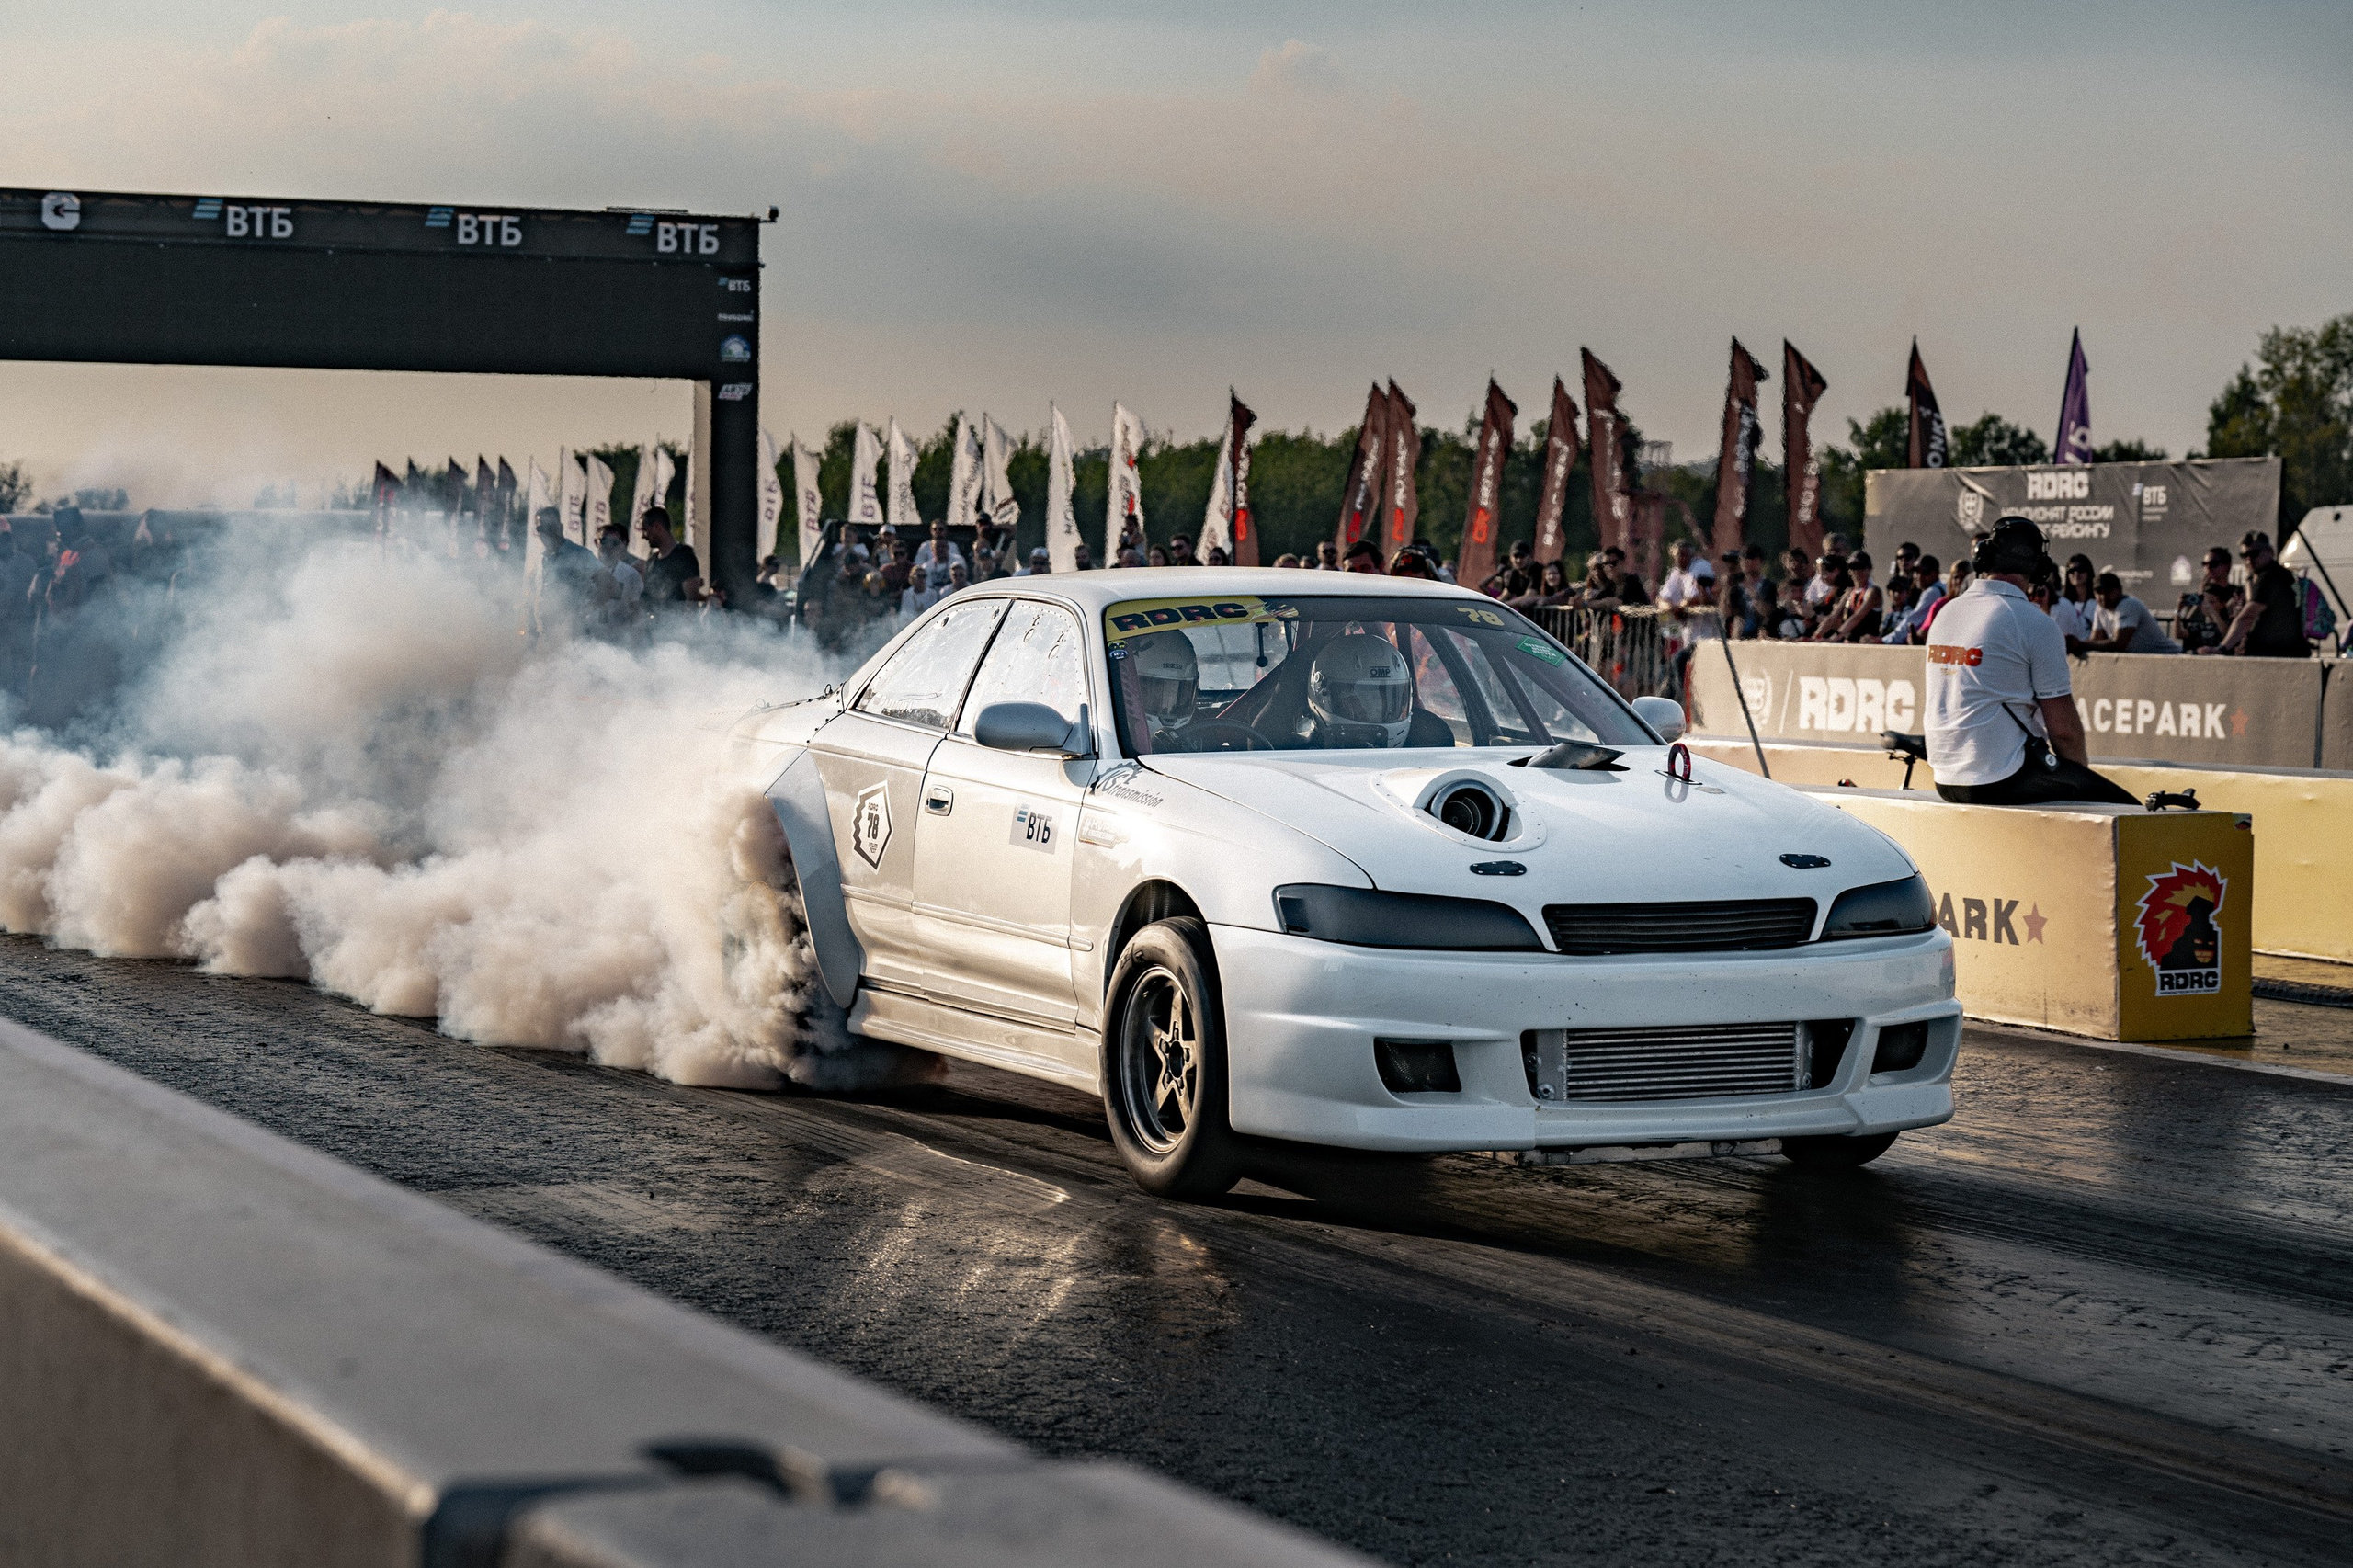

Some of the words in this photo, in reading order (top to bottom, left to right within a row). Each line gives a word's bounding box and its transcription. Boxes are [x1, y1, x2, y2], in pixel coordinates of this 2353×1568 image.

[226, 205, 293, 239] ВТБ
[456, 214, 523, 247] ВТБ
[657, 222, 720, 255] ВТБ
[727, 279, 751, 292] ВТБ
[2142, 485, 2167, 506] ВТБ
[1108, 602, 1249, 632] RDRC
[1455, 607, 1505, 626] 78
[1370, 668, 1391, 676] OMP
[1799, 676, 1916, 733] RDRC
[867, 812, 880, 840] 78
[1026, 812, 1053, 844] ВТБ
[2159, 971, 2219, 991] RDRC
